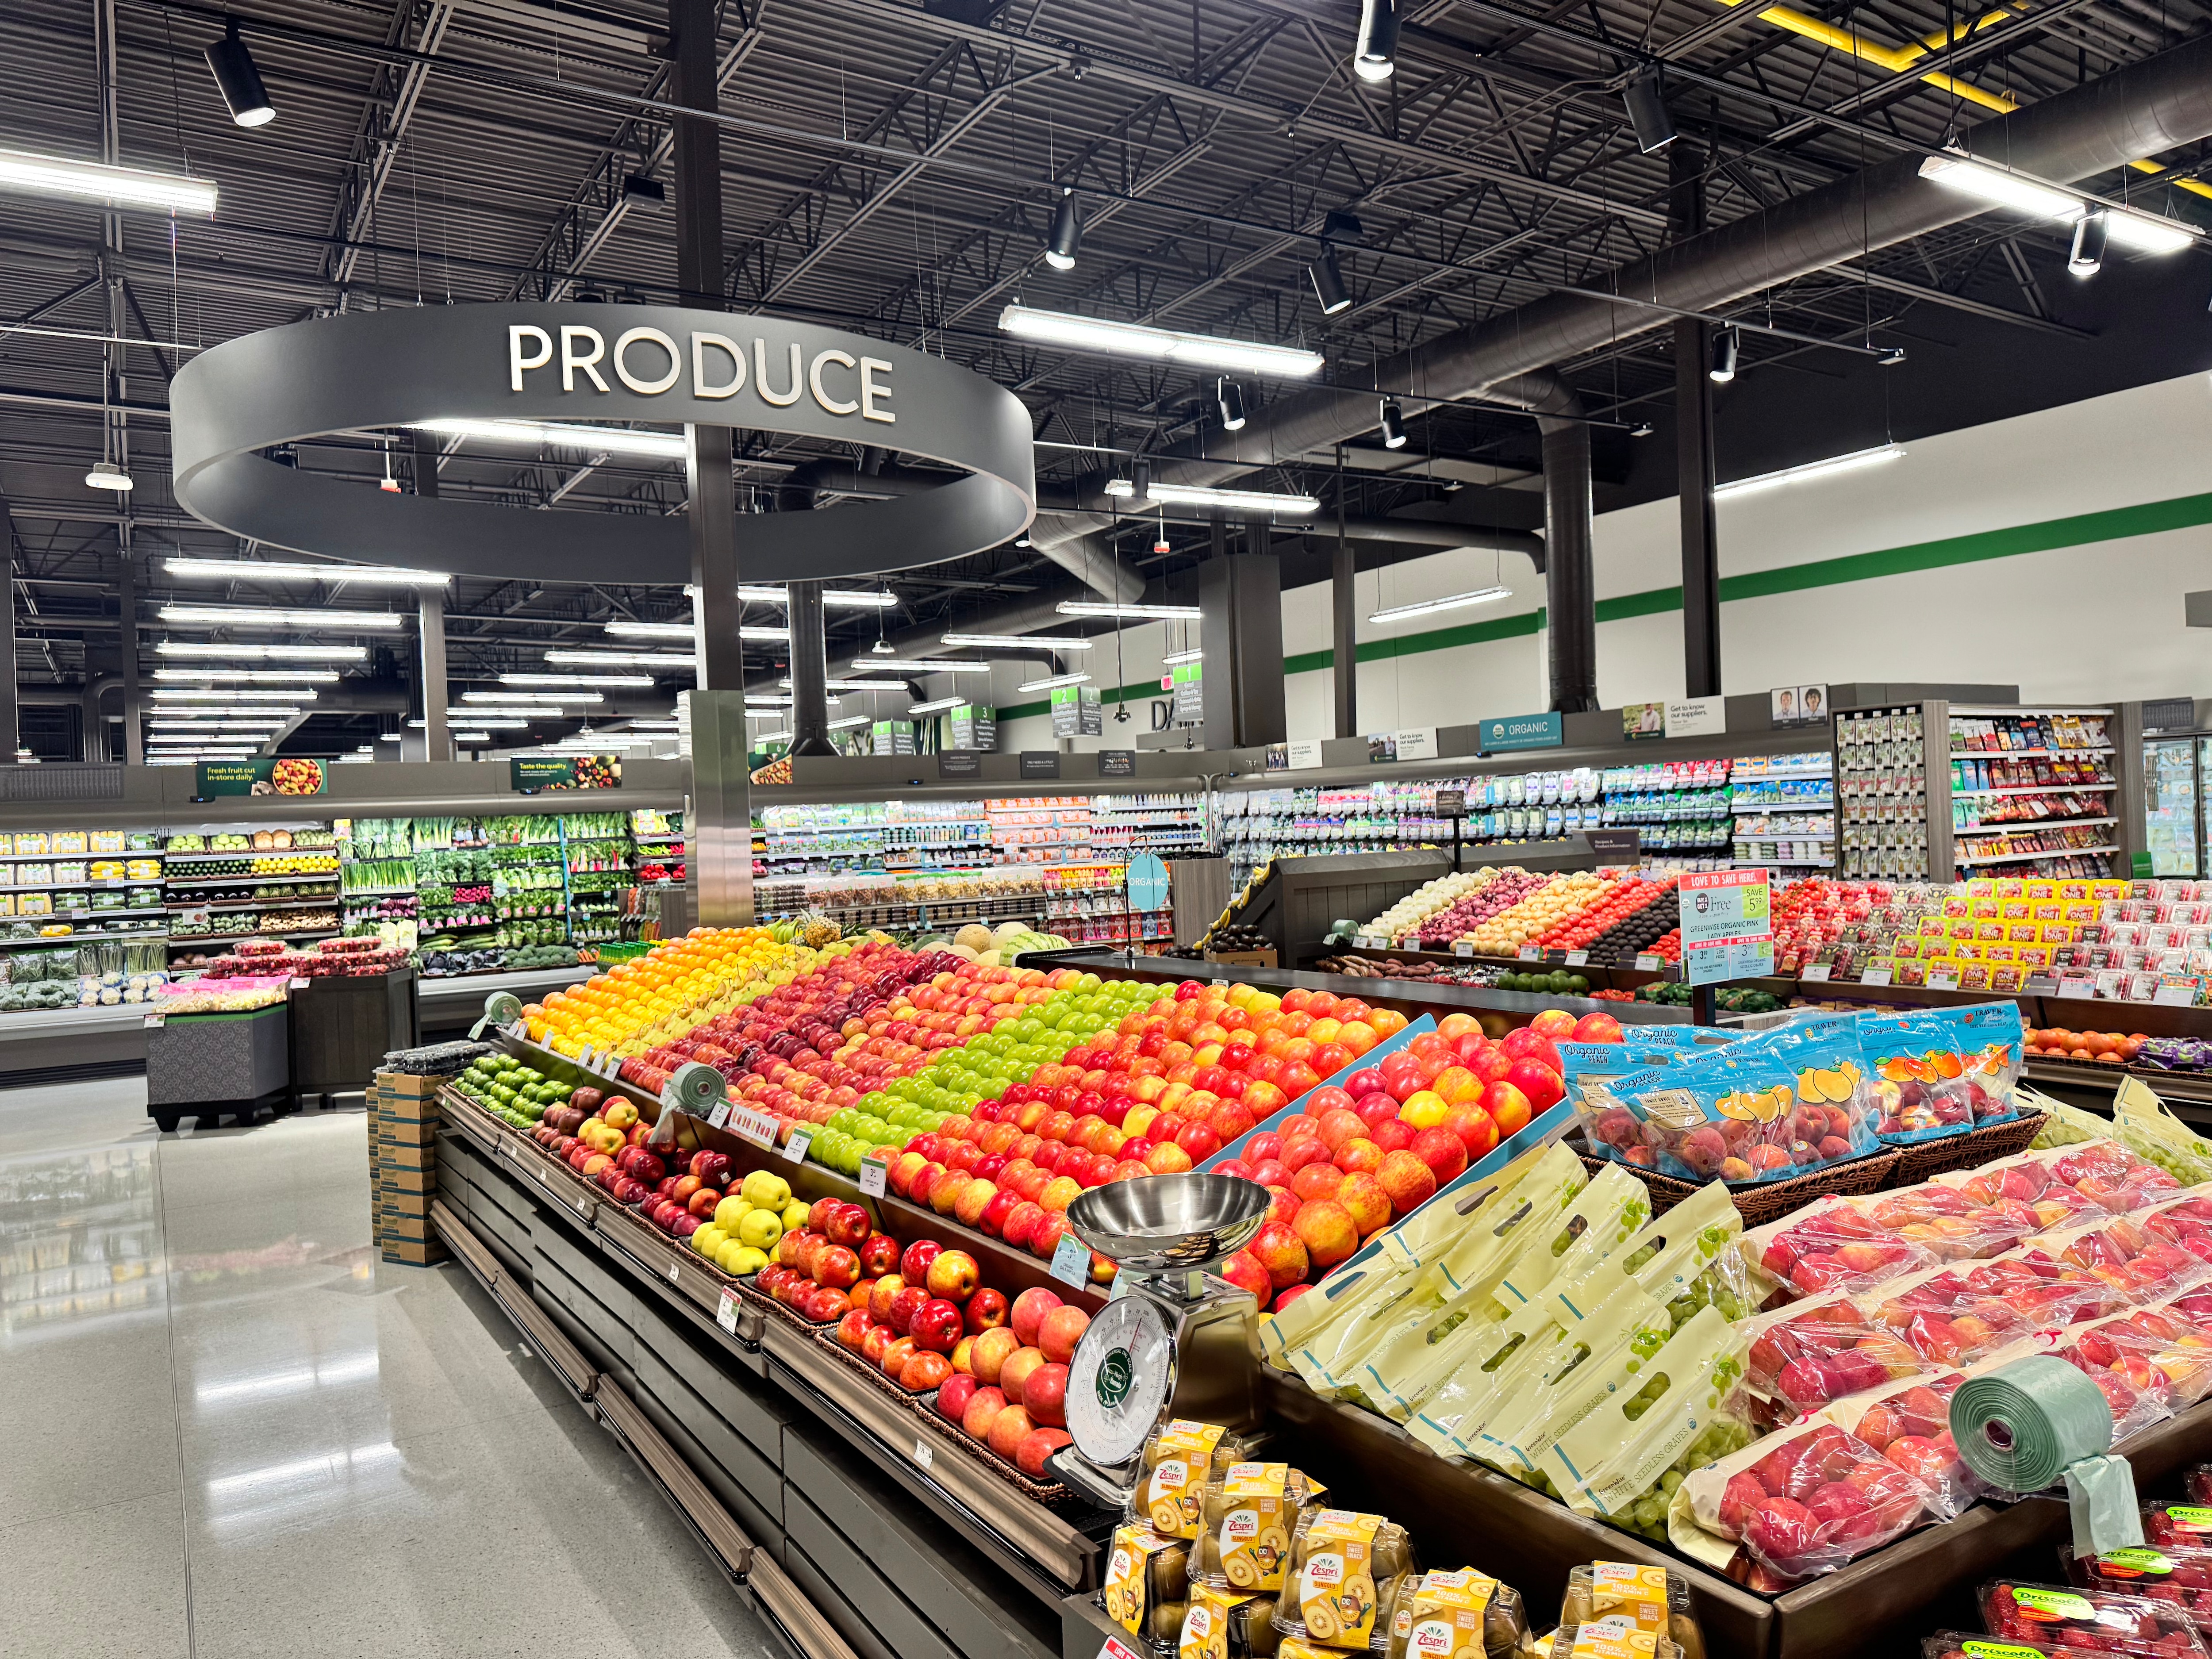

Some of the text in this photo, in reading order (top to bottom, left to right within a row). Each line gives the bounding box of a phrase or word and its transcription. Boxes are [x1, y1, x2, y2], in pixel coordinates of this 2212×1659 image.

[509, 325, 896, 422] PRODUCE
[1187, 666, 1191, 680] 1
[1061, 689, 1067, 702] 2
[1089, 689, 1093, 700] 2
[983, 707, 987, 718] 3
[1682, 710, 1708, 719] suppliers.
[902, 722, 906, 732] 4
[1509, 722, 1548, 735] ORGANIC
[833, 733, 837, 742] 5
[1691, 872, 1756, 887] LOVE TO SAVE HERE.
[1747, 888, 1763, 897] SAVE
[1711, 896, 1731, 911] Free
[1690, 923, 1720, 932] GREENWISE
[1720, 921, 1746, 929] ORGANIC
[1974, 1008, 2002, 1017] TRAVER
[1811, 1021, 1837, 1031] TRAVER
[1632, 1028, 1678, 1043] Organic
[1655, 1037, 1675, 1046] PEACH
[1564, 1044, 1610, 1059] Organic
[1588, 1055, 1608, 1064] PEACH
[1613, 1070, 1661, 1091] Organic
[1653, 1282, 1675, 1301] GRAPES
[1388, 1326, 1410, 1346] GRAPES
[1408, 1382, 1428, 1401] GreenWise
[1413, 1388, 1435, 1407] WHITE
[1466, 1420, 1486, 1442] GreenWise
[1530, 1390, 1607, 1460] WHITE SEEDLESS GRAPES
[1525, 1431, 1546, 1452] GreenWise
[1604, 1427, 1689, 1503] WHITE SEEDLESS GRAPES
[1159, 1469, 1183, 1481] Zespri
[1598, 1475, 1627, 1495] GreenWise
[1228, 1520, 1255, 1532] Zespri
[1114, 1555, 1128, 1573] Zespri
[1311, 1563, 1339, 1577] Zespri
[1314, 1581, 1336, 1590] SUNGOLD
[1430, 1575, 1461, 1585] Zespri
[1433, 1594, 1463, 1603] VITAMIN
[1436, 1590, 1461, 1599] 100%
[2017, 1592, 2086, 1607] Driscoll's
[1190, 1613, 1208, 1630] Zespri
[1318, 1598, 1344, 1634] 100% VITAMIN
[1457, 1621, 1475, 1630] SNACK
[1584, 1627, 1618, 1637] Zespri
[1417, 1632, 1449, 1648] Zespri
[1114, 1646, 1126, 1658] LOVE
[1593, 1649, 1626, 1658] VITAMIN
[1594, 1643, 1622, 1653] 100%
[1970, 1644, 2040, 1659] Driscoll's
